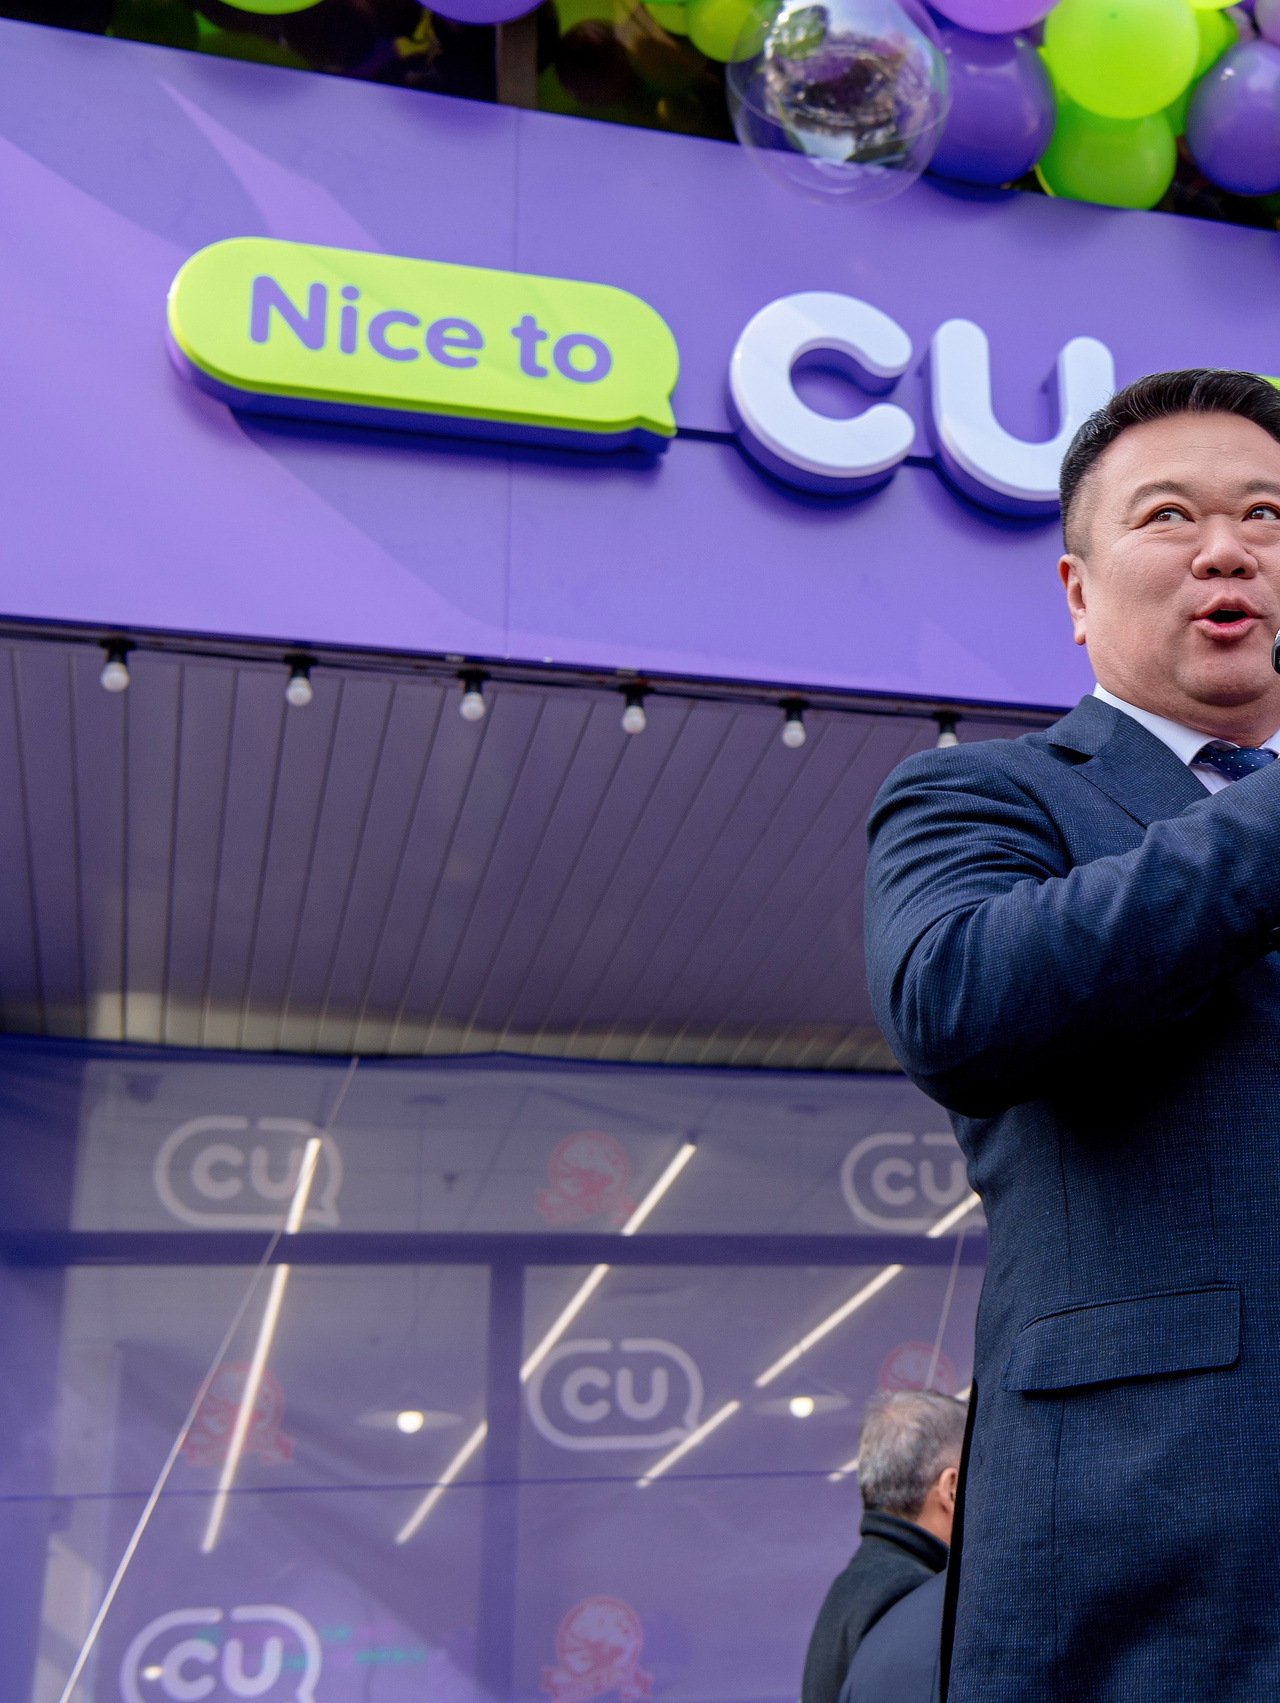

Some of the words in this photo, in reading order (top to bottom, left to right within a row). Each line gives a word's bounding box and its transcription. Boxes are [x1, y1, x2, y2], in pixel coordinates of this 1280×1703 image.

[248, 274, 484, 370] Nice
[512, 313, 613, 384] to
[728, 290, 1115, 512] CU
[190, 1143, 308, 1201] CU
[870, 1157, 968, 1206] CU
[561, 1366, 669, 1421] CU
[160, 1635, 284, 1702] CU
